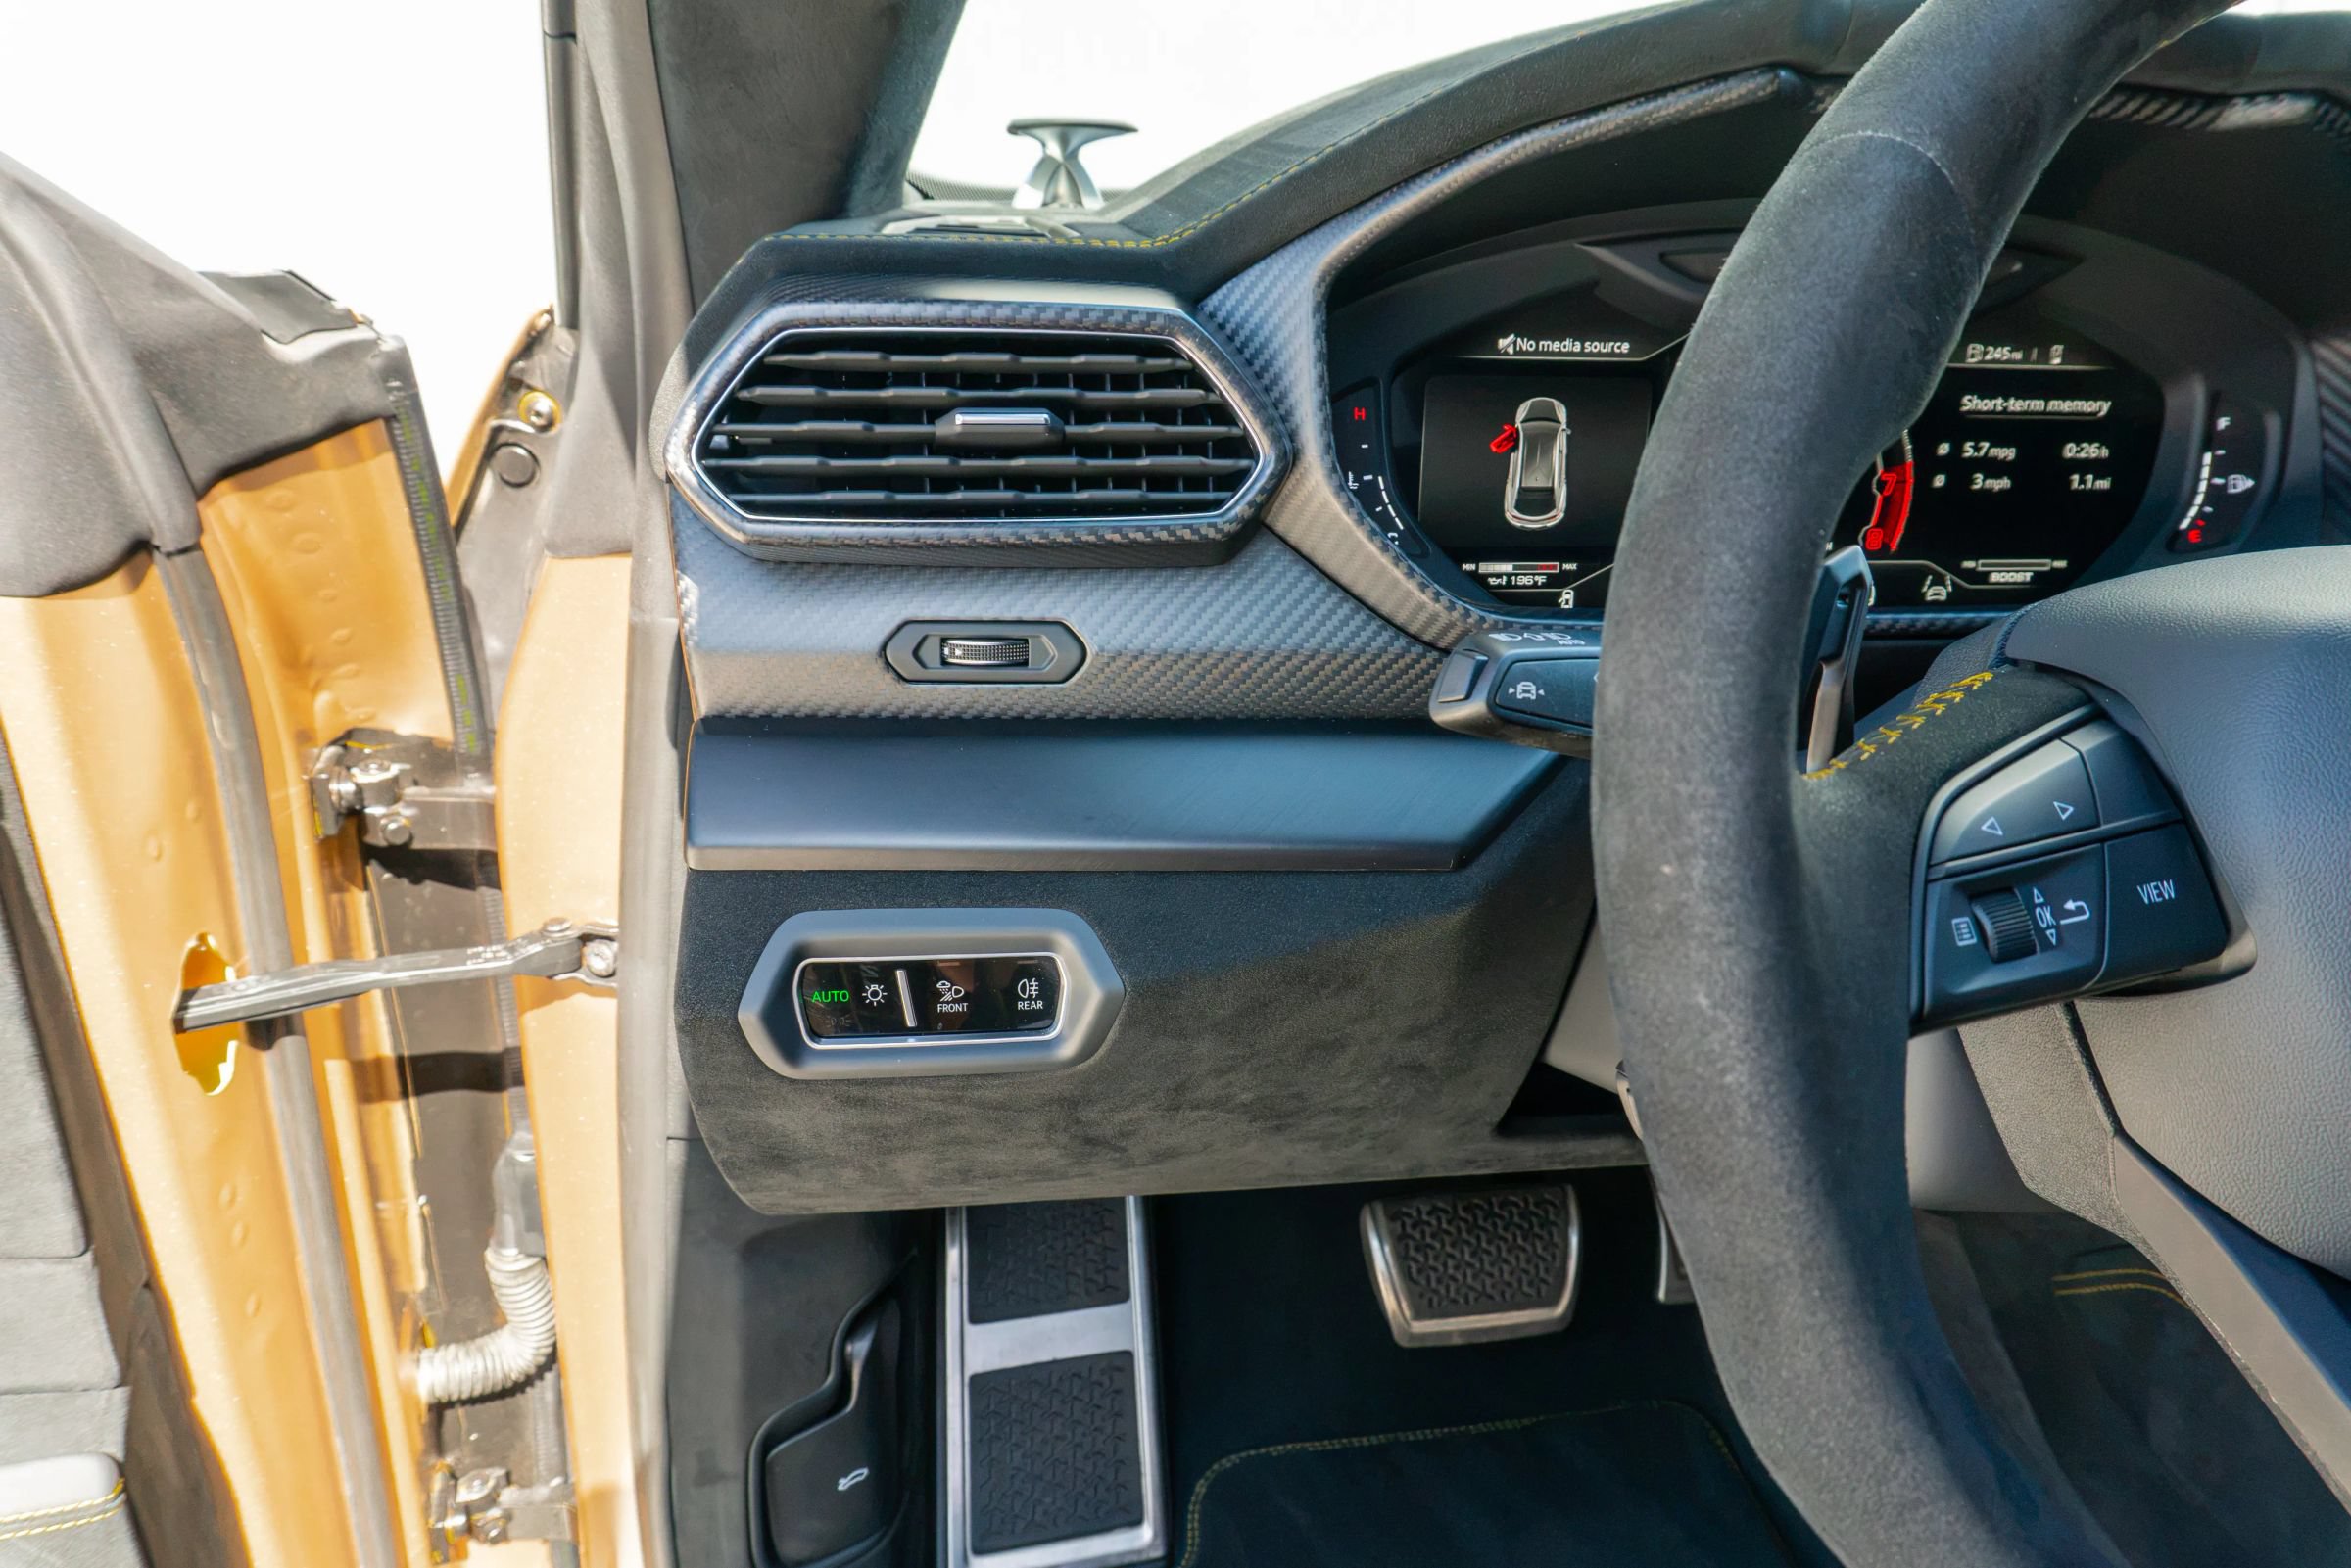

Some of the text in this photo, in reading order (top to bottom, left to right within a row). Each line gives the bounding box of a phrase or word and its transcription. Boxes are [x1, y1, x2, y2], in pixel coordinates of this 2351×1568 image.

[1516, 337, 1630, 354] No media source
[1353, 406, 1367, 421] H
[1960, 395, 2112, 417] Short-term memory
[2216, 416, 2231, 432] F
[1881, 473, 1897, 496] 7
[1865, 527, 1884, 550] 8
[2187, 529, 2202, 544] E
[2136, 879, 2177, 905] VIEW
[2035, 906, 2057, 928] OK
[811, 989, 850, 1004] AUTO
[936, 1002, 969, 1014] FRONT
[1017, 1000, 1043, 1011] REAR
